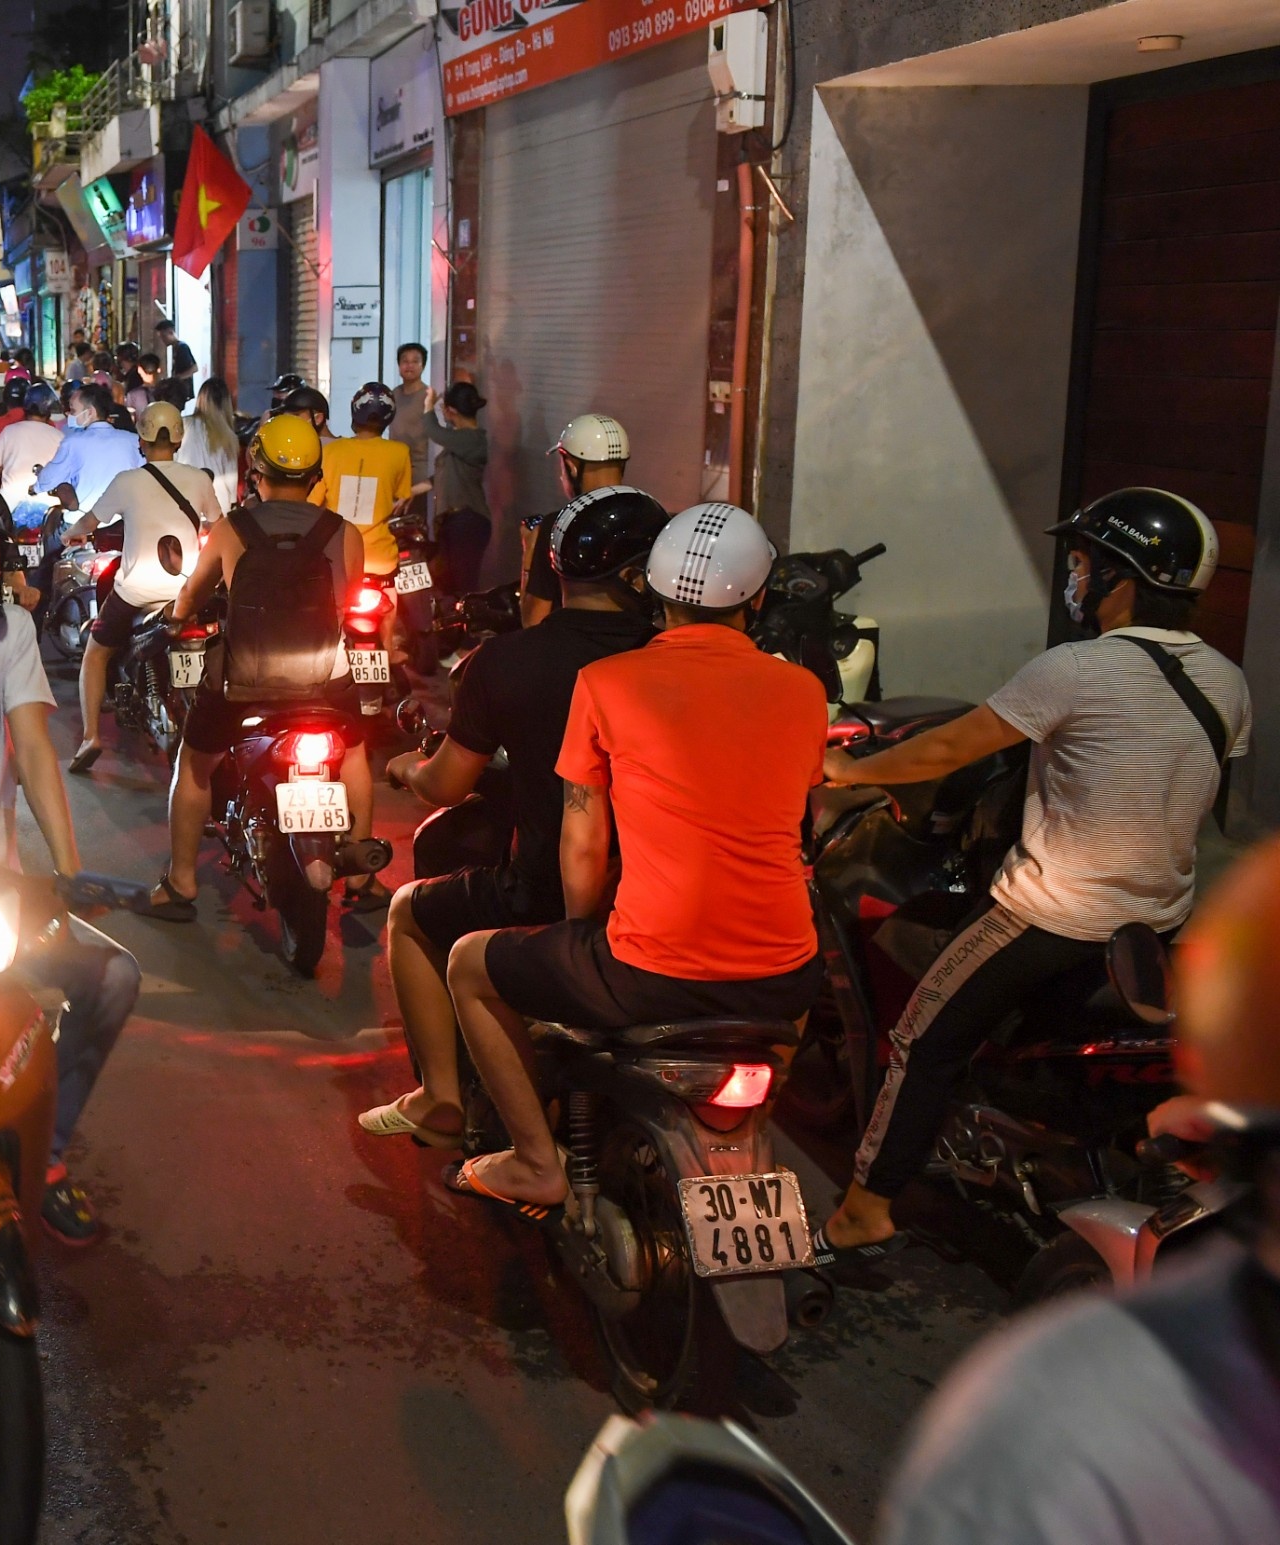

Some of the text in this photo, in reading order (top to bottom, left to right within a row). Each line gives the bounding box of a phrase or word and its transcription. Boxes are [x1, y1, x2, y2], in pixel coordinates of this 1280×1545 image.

[609, 25, 630, 52] 0913
[632, 21, 653, 44] 590
[654, 8, 675, 35] 899
[685, 0, 716, 23] 0904
[50, 258, 66, 274] 104
[1107, 515, 1151, 546] BAC A BANK
[284, 808, 345, 829] 617.85
[699, 1179, 782, 1222] 30-M7
[711, 1221, 796, 1266] 4881
